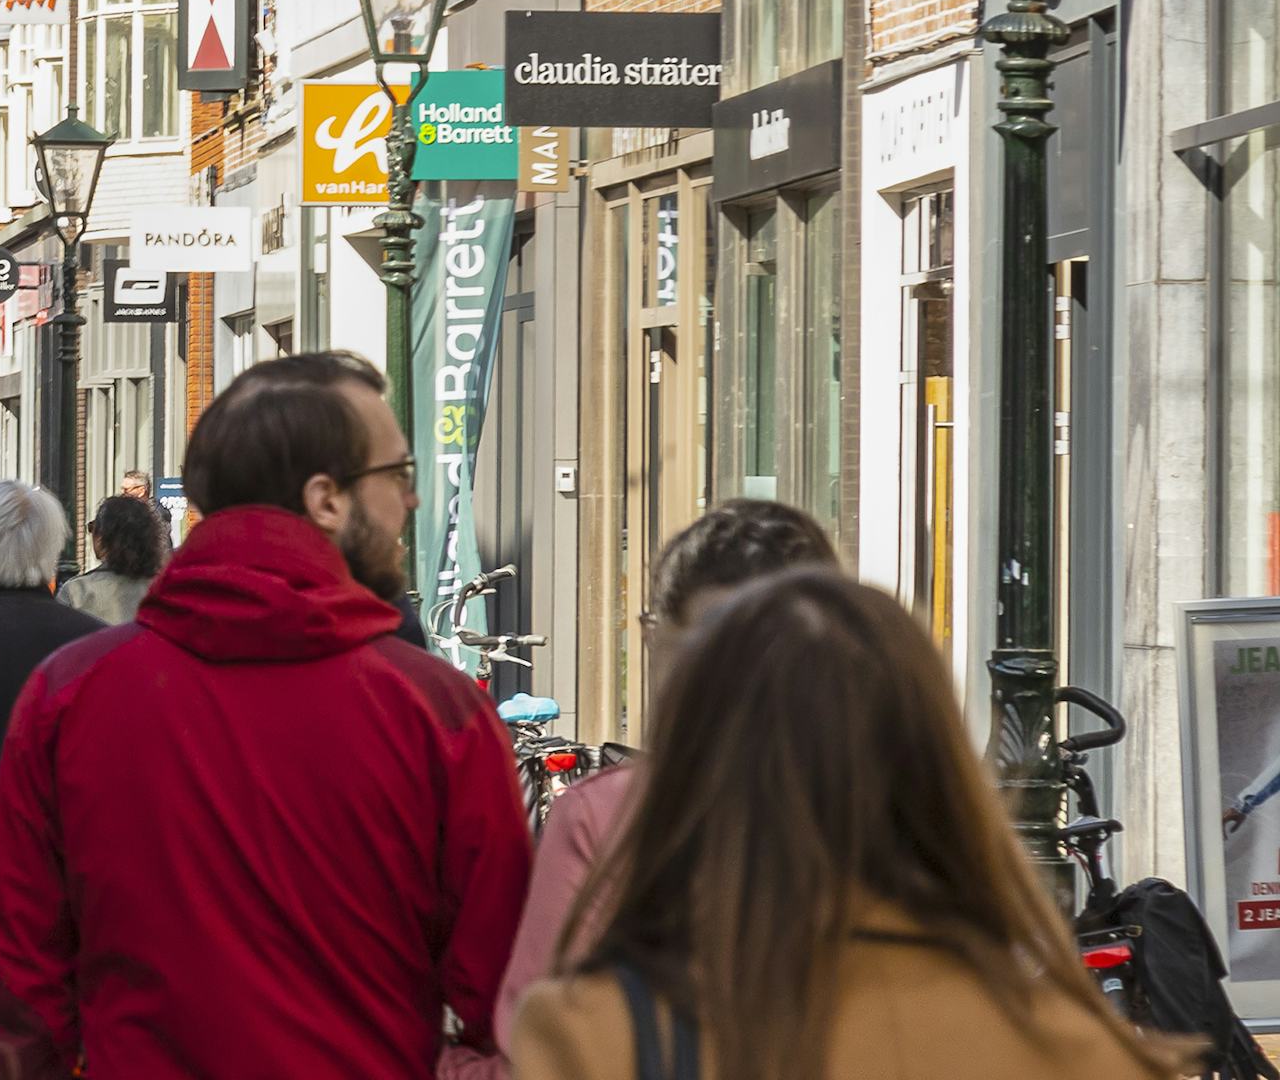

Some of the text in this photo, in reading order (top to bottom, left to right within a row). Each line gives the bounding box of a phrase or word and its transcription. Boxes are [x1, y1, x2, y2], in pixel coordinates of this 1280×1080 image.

[514, 52, 722, 86] claudia sträter
[418, 103, 502, 123] Holland
[315, 180, 389, 195] vanHar
[145, 228, 237, 247] PANDORA
[1243, 908, 1255, 923] 2
